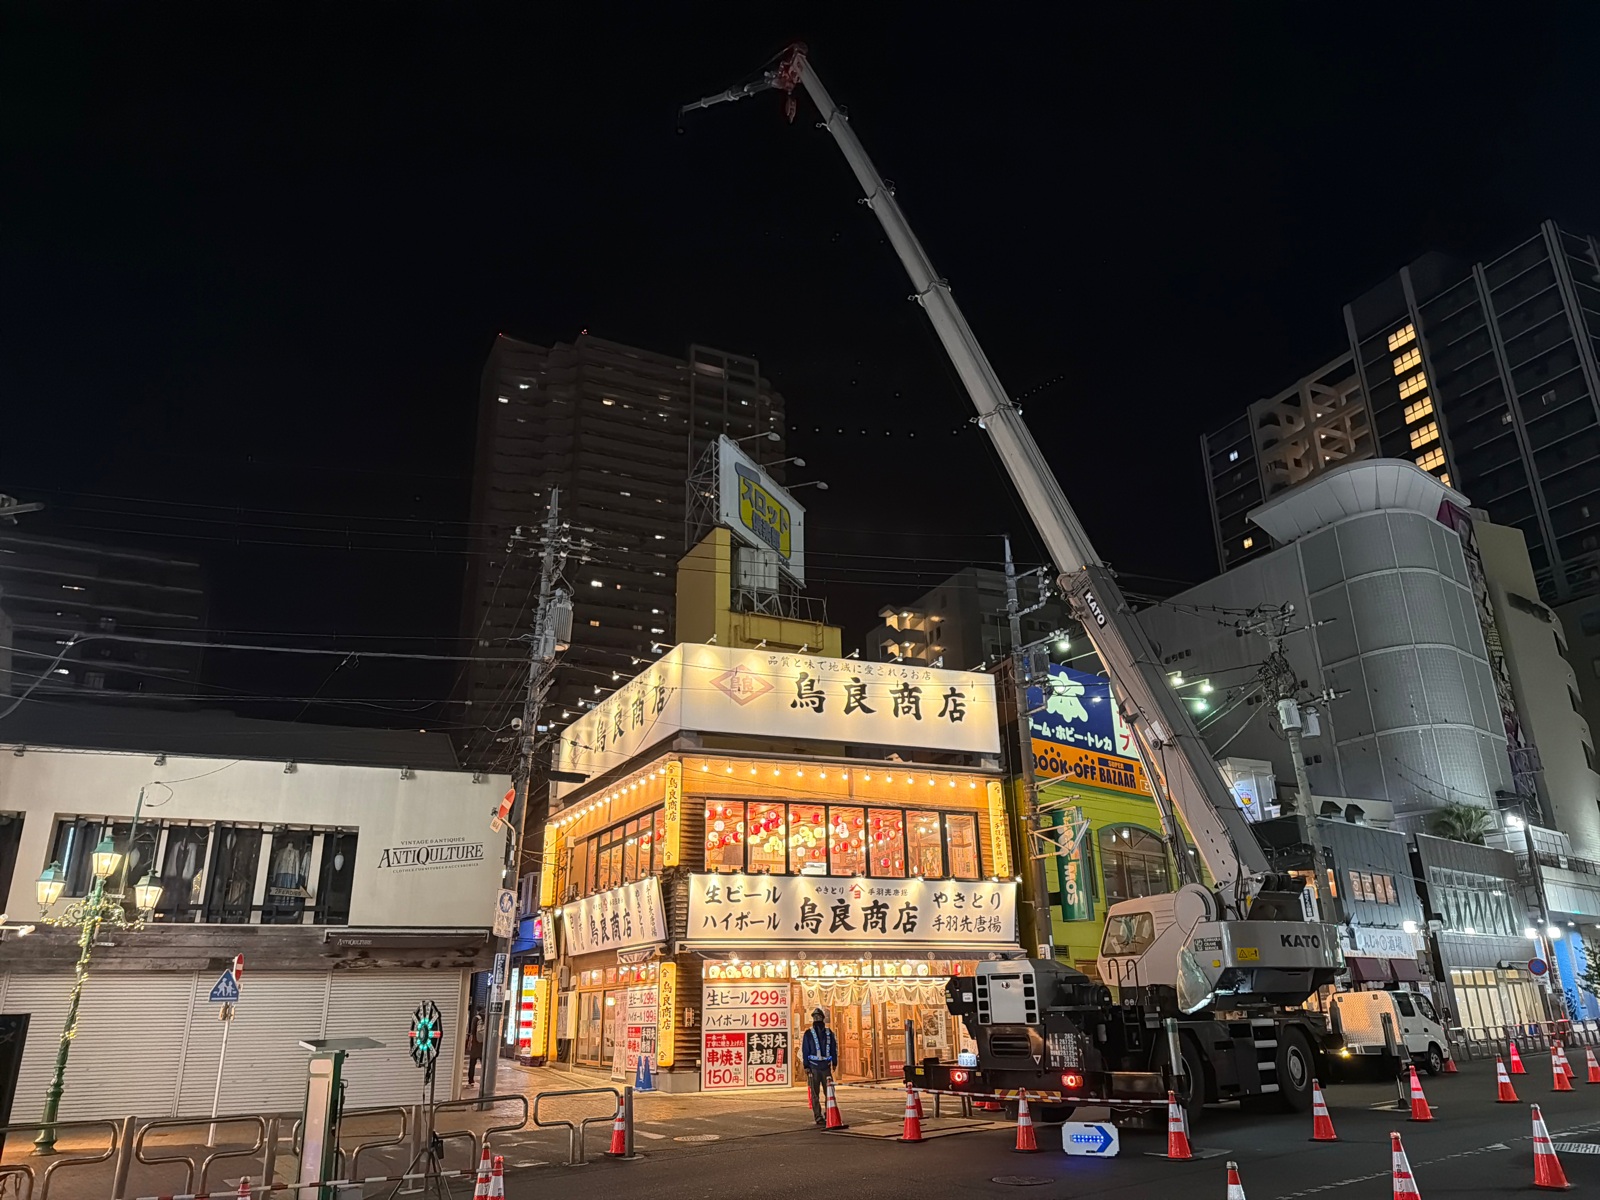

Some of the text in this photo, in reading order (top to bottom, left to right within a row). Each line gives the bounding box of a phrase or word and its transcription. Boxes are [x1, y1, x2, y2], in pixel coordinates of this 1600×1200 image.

[742, 478, 788, 534] スロット
[1085, 592, 1105, 625] KATO
[768, 655, 932, 682] 品質と味で地域に愛されるお店
[790, 671, 967, 723] 鳥良商店
[594, 675, 665, 753] 鳥良商店
[1108, 760, 1124, 770] SUPER
[1100, 767, 1136, 789] BAZAAR
[668, 777, 678, 821] 鳥良商店
[815, 886, 845, 896] やきとり
[1064, 863, 1079, 906] MOS
[705, 885, 782, 905] 生ビール
[933, 891, 1001, 910] やきとり
[702, 912, 781, 931] ハイボール
[794, 897, 920, 935] 鳥良商店
[932, 915, 1002, 934] 手羽先唐揚
[590, 908, 632, 947] 鳥良商店
[1280, 934, 1320, 949] KATO
[662, 981, 672, 1030] 鳥良商店
[707, 989, 750, 1007] 生ビール
[706, 1013, 749, 1027] ハイボール
[748, 1033, 787, 1048] 手羽先
[707, 1049, 743, 1067] 串焼き
[748, 1048, 775, 1064] 唐揚
